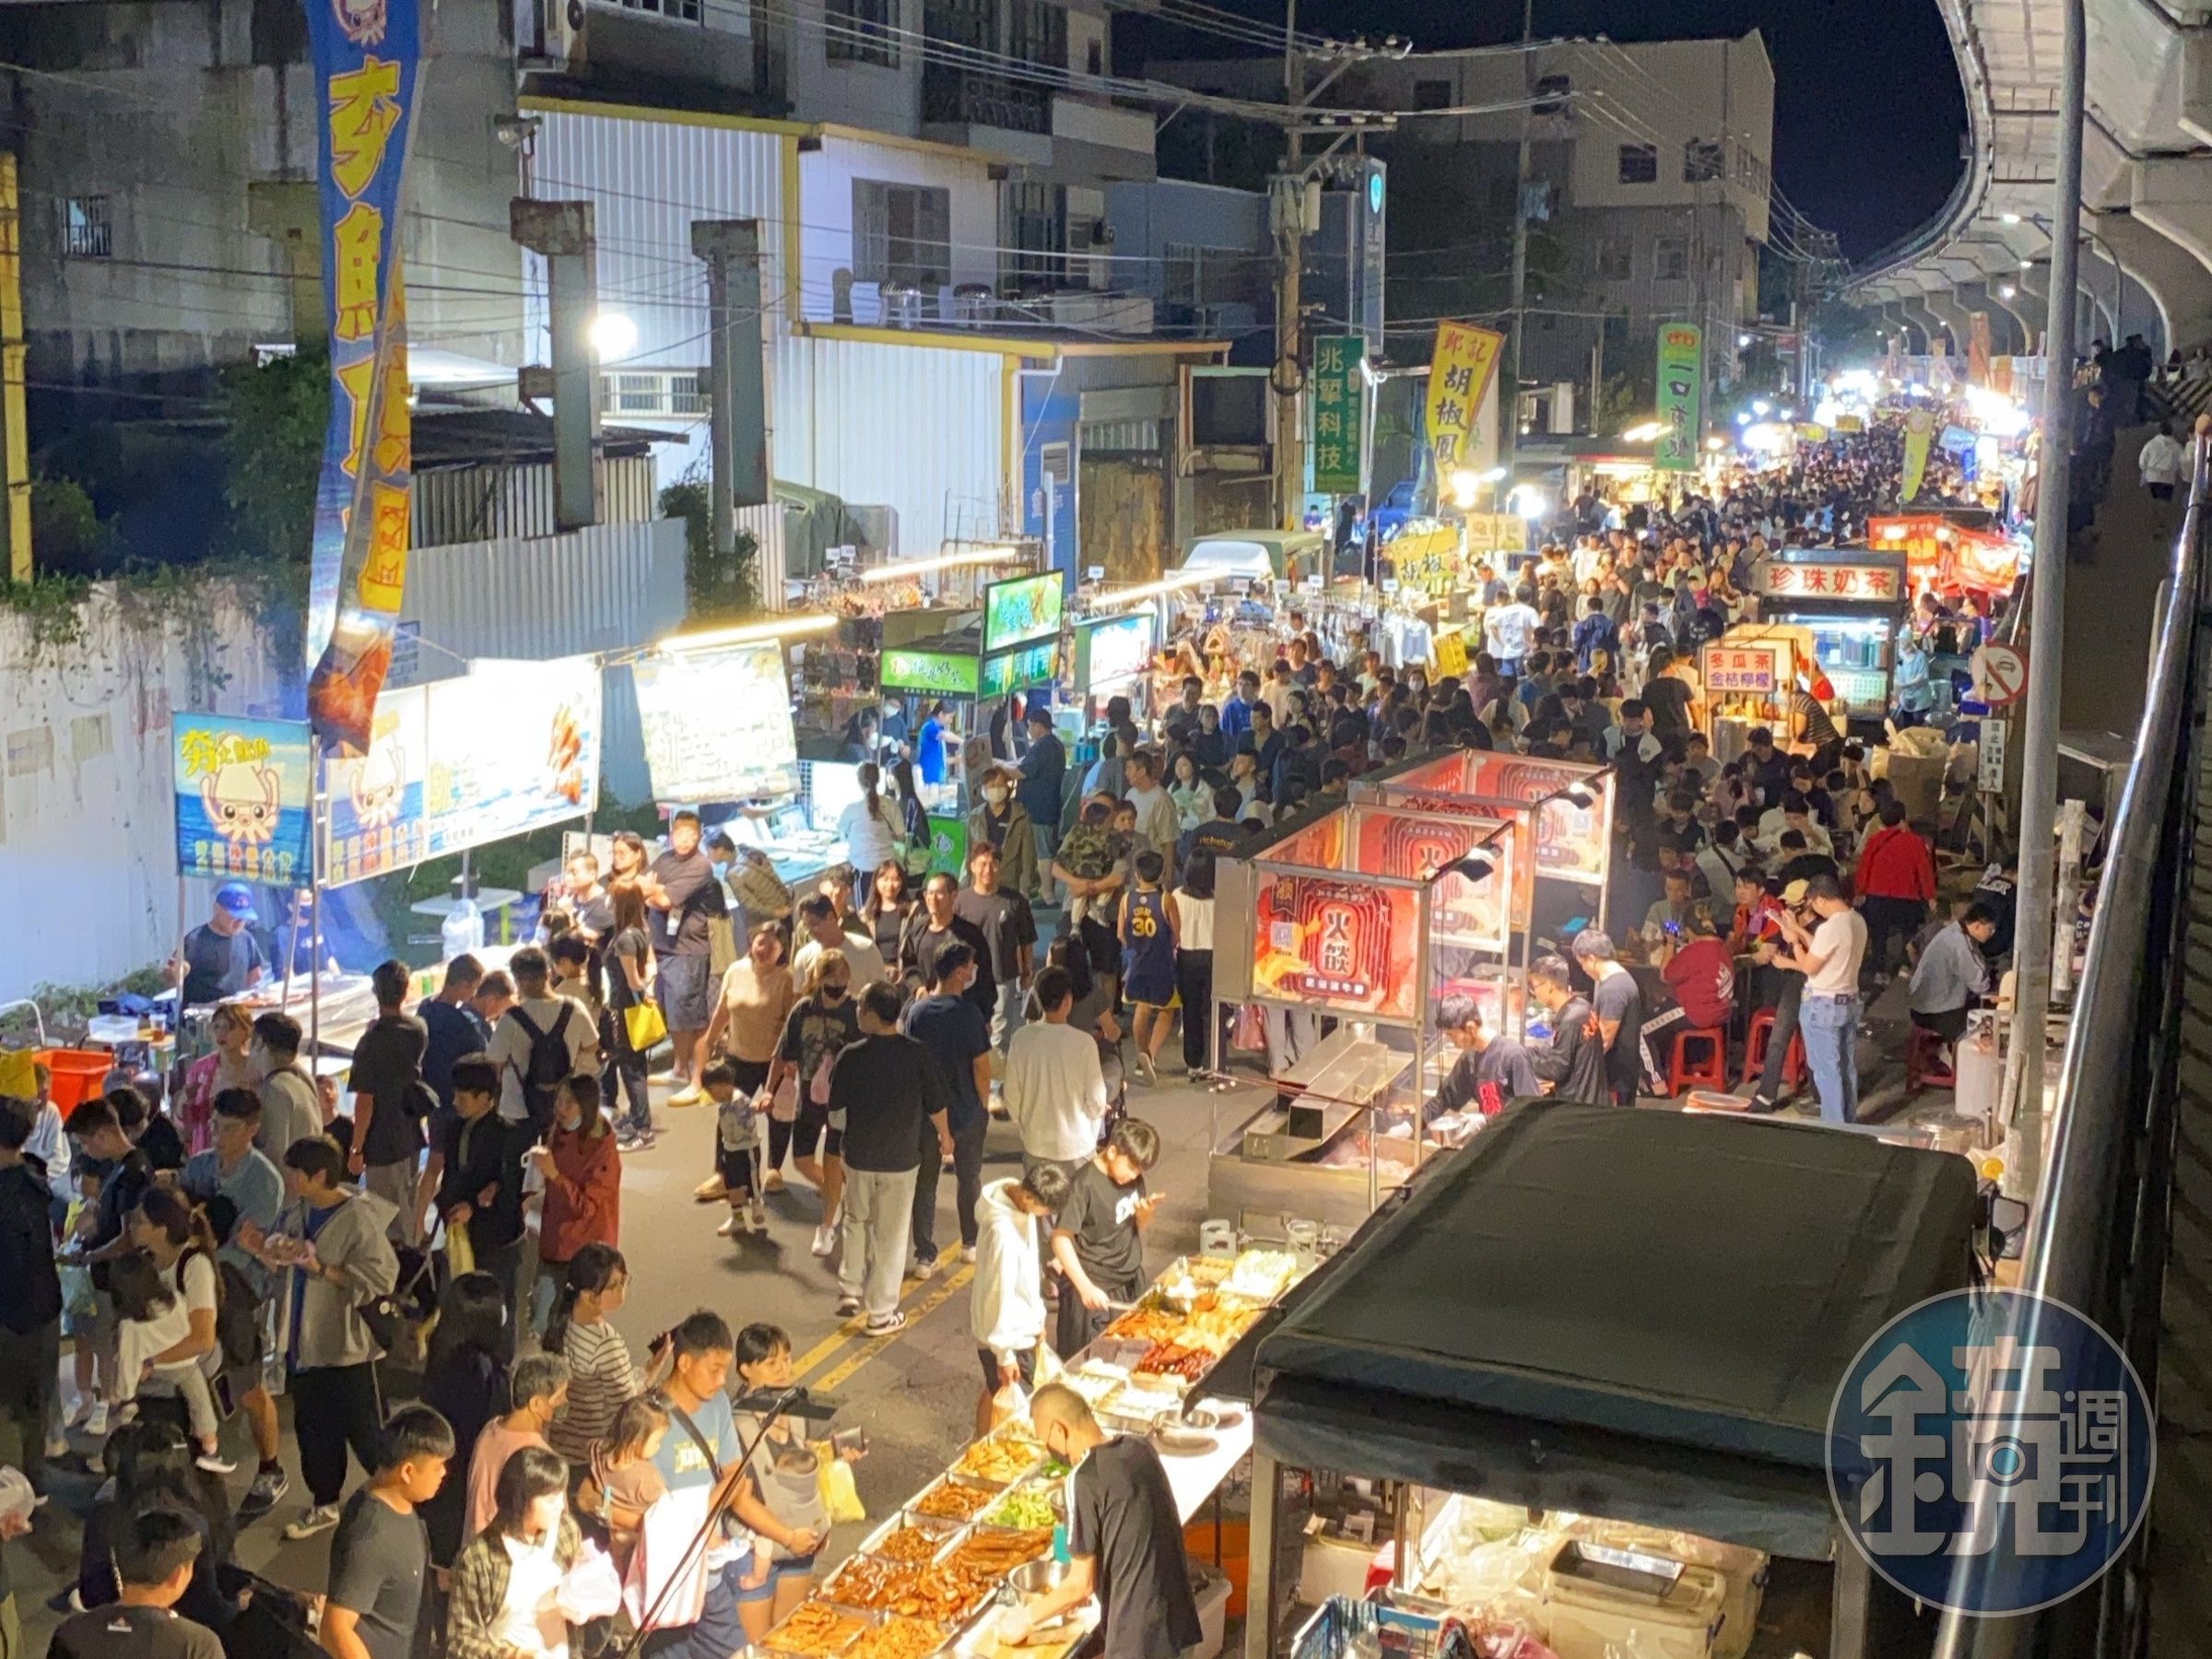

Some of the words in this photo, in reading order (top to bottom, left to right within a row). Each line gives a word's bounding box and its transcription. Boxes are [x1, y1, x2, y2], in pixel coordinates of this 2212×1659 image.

[1770, 567, 1891, 596] 珍珠奶茶
[1711, 653, 1770, 670] 冬瓜茶
[1710, 671, 1771, 688] 金桔檸檬
[1131, 916, 1157, 938] 30
